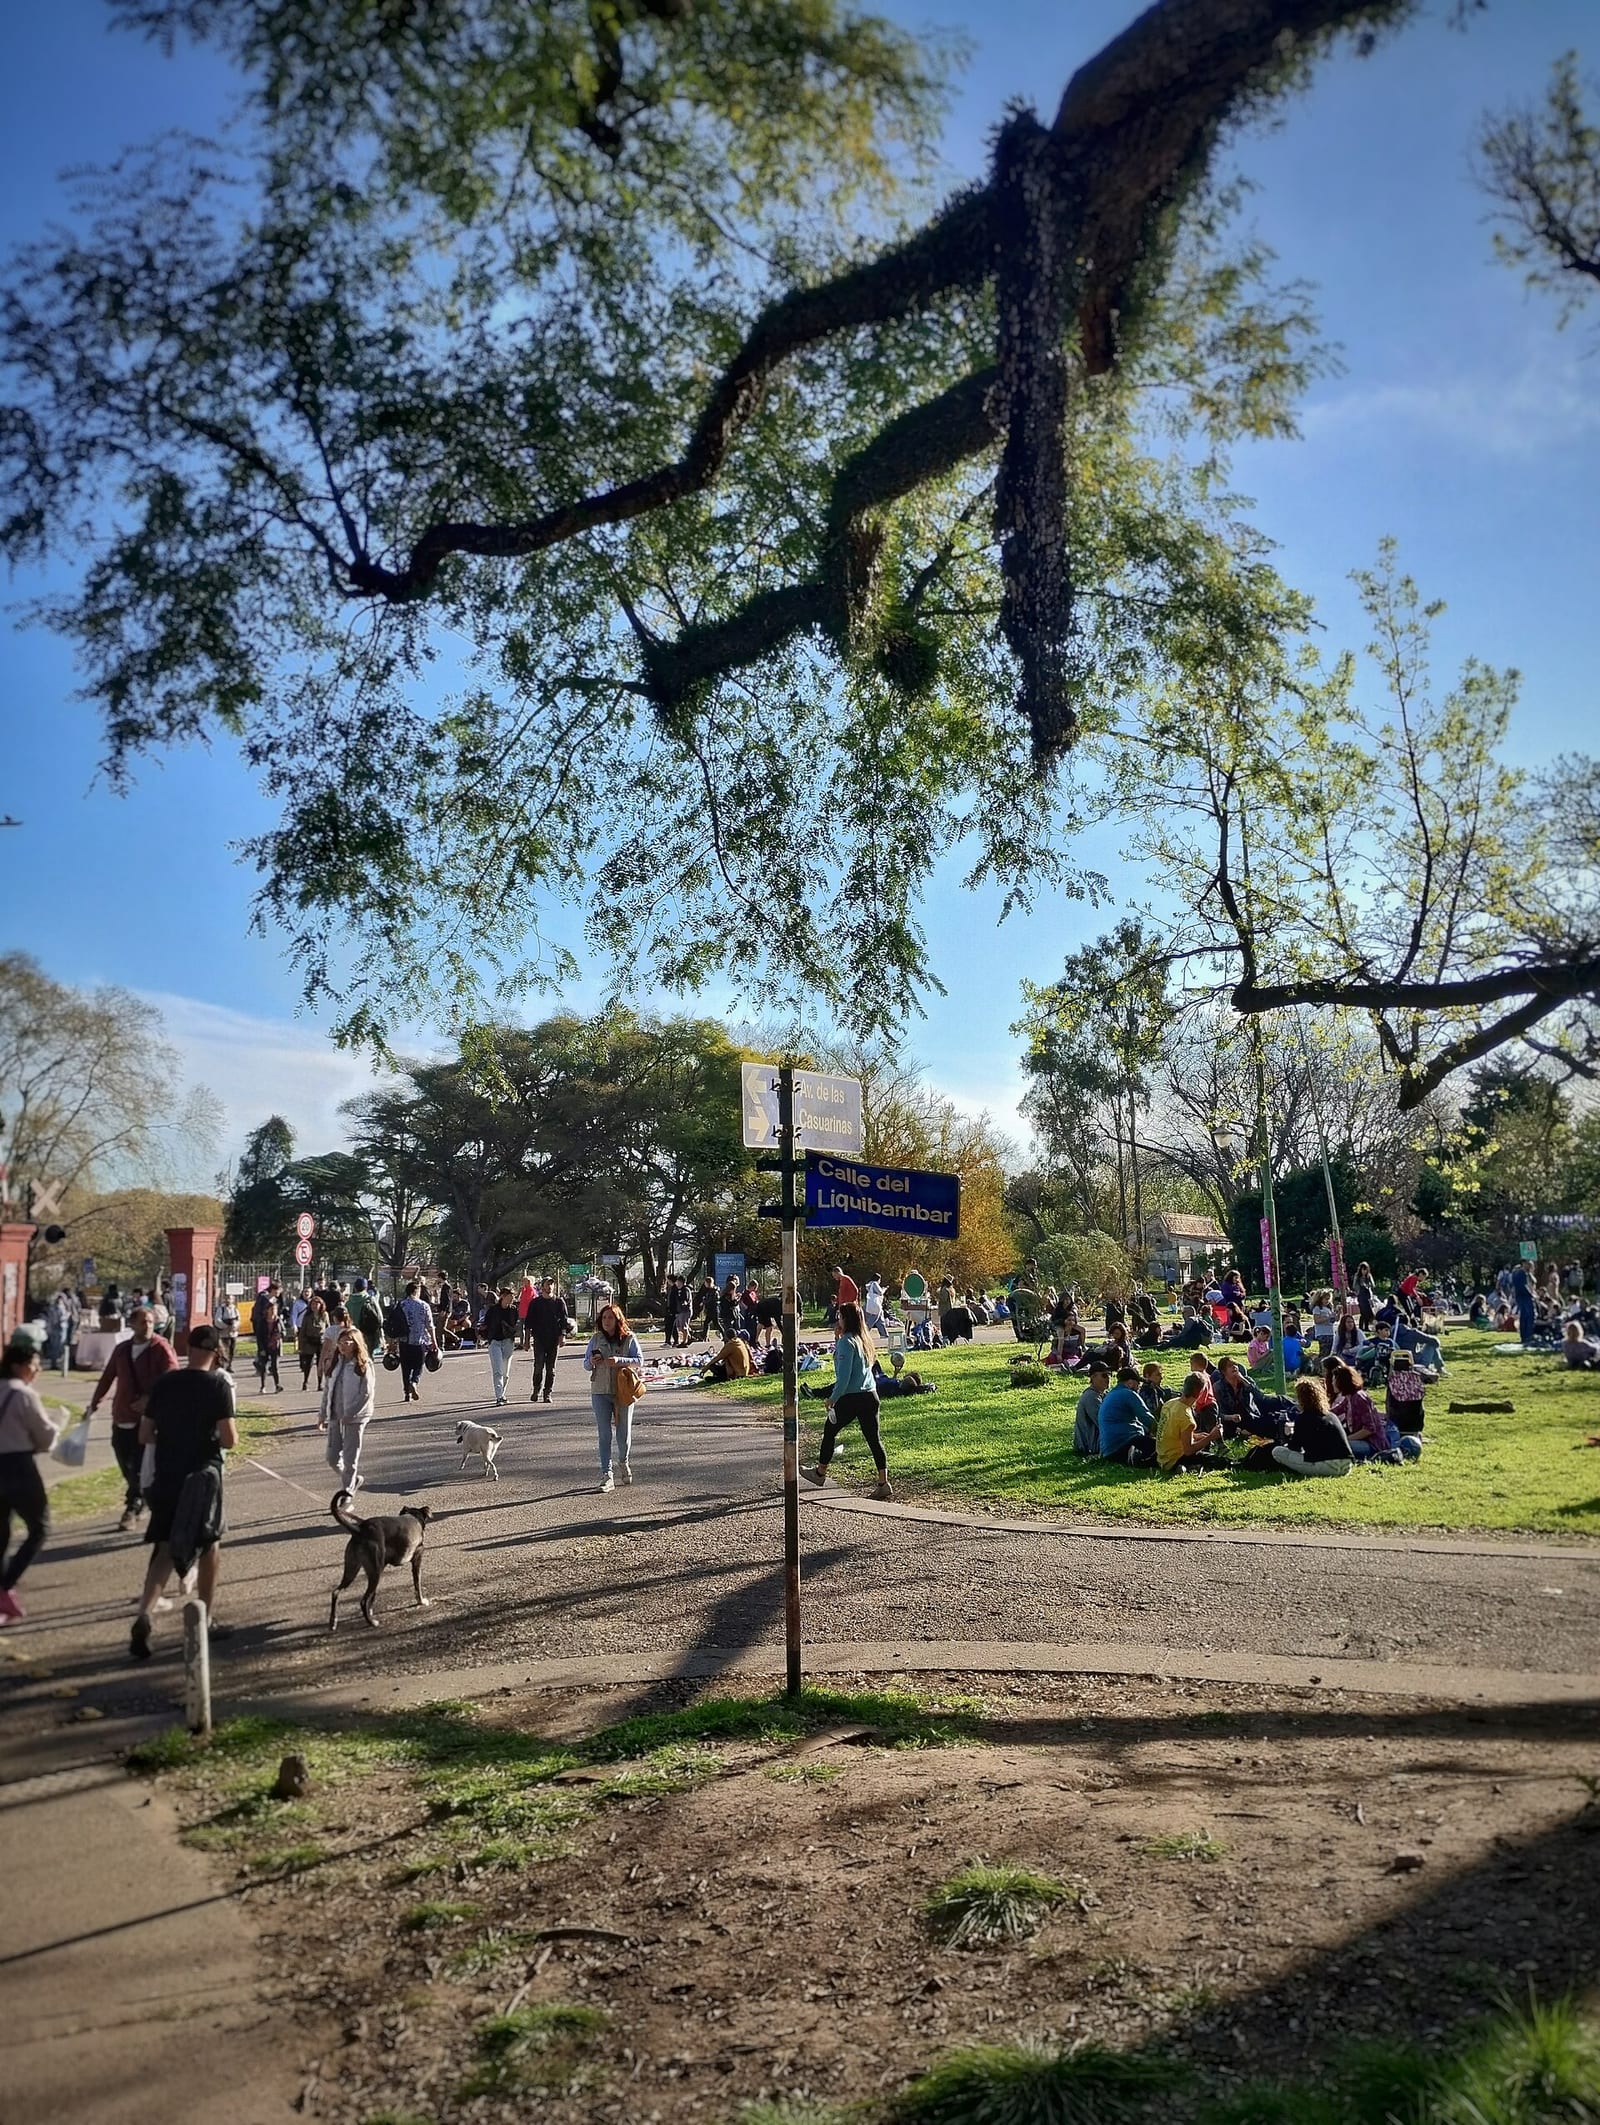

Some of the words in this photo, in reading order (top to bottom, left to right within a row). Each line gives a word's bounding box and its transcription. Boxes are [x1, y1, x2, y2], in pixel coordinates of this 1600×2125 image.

[800, 1078, 814, 1099] Av.
[816, 1081, 829, 1102] de
[831, 1083, 845, 1104] las
[799, 1108, 853, 1135] Casuarinas
[818, 1160, 871, 1188] Calle
[876, 1174, 910, 1193] del
[817, 1189, 952, 1224] Liquibambar
